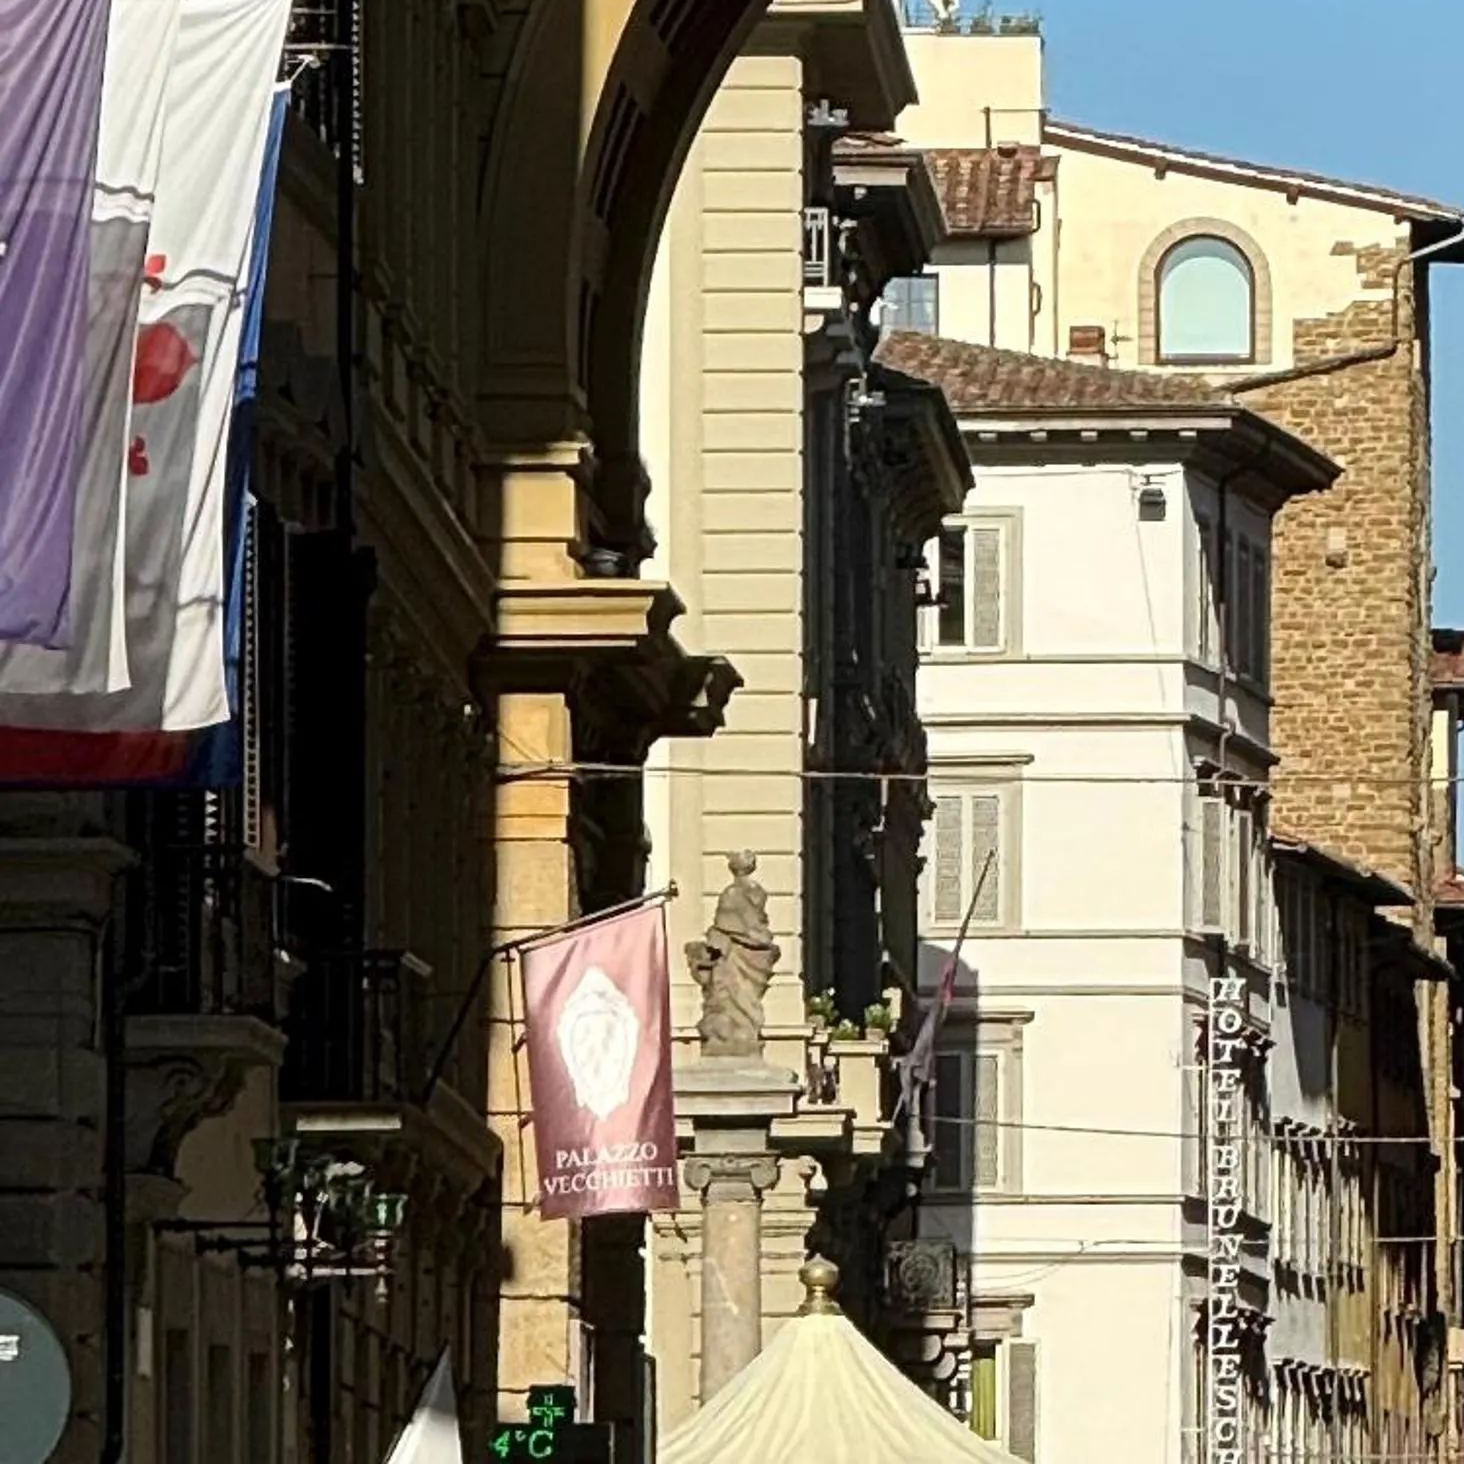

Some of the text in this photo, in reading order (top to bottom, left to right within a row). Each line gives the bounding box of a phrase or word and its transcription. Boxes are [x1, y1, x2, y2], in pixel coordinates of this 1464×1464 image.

[1215, 977, 1247, 1124] HOTEL
[555, 1141, 658, 1169] PALAZZO
[543, 1166, 674, 1195] VECCHIETTI
